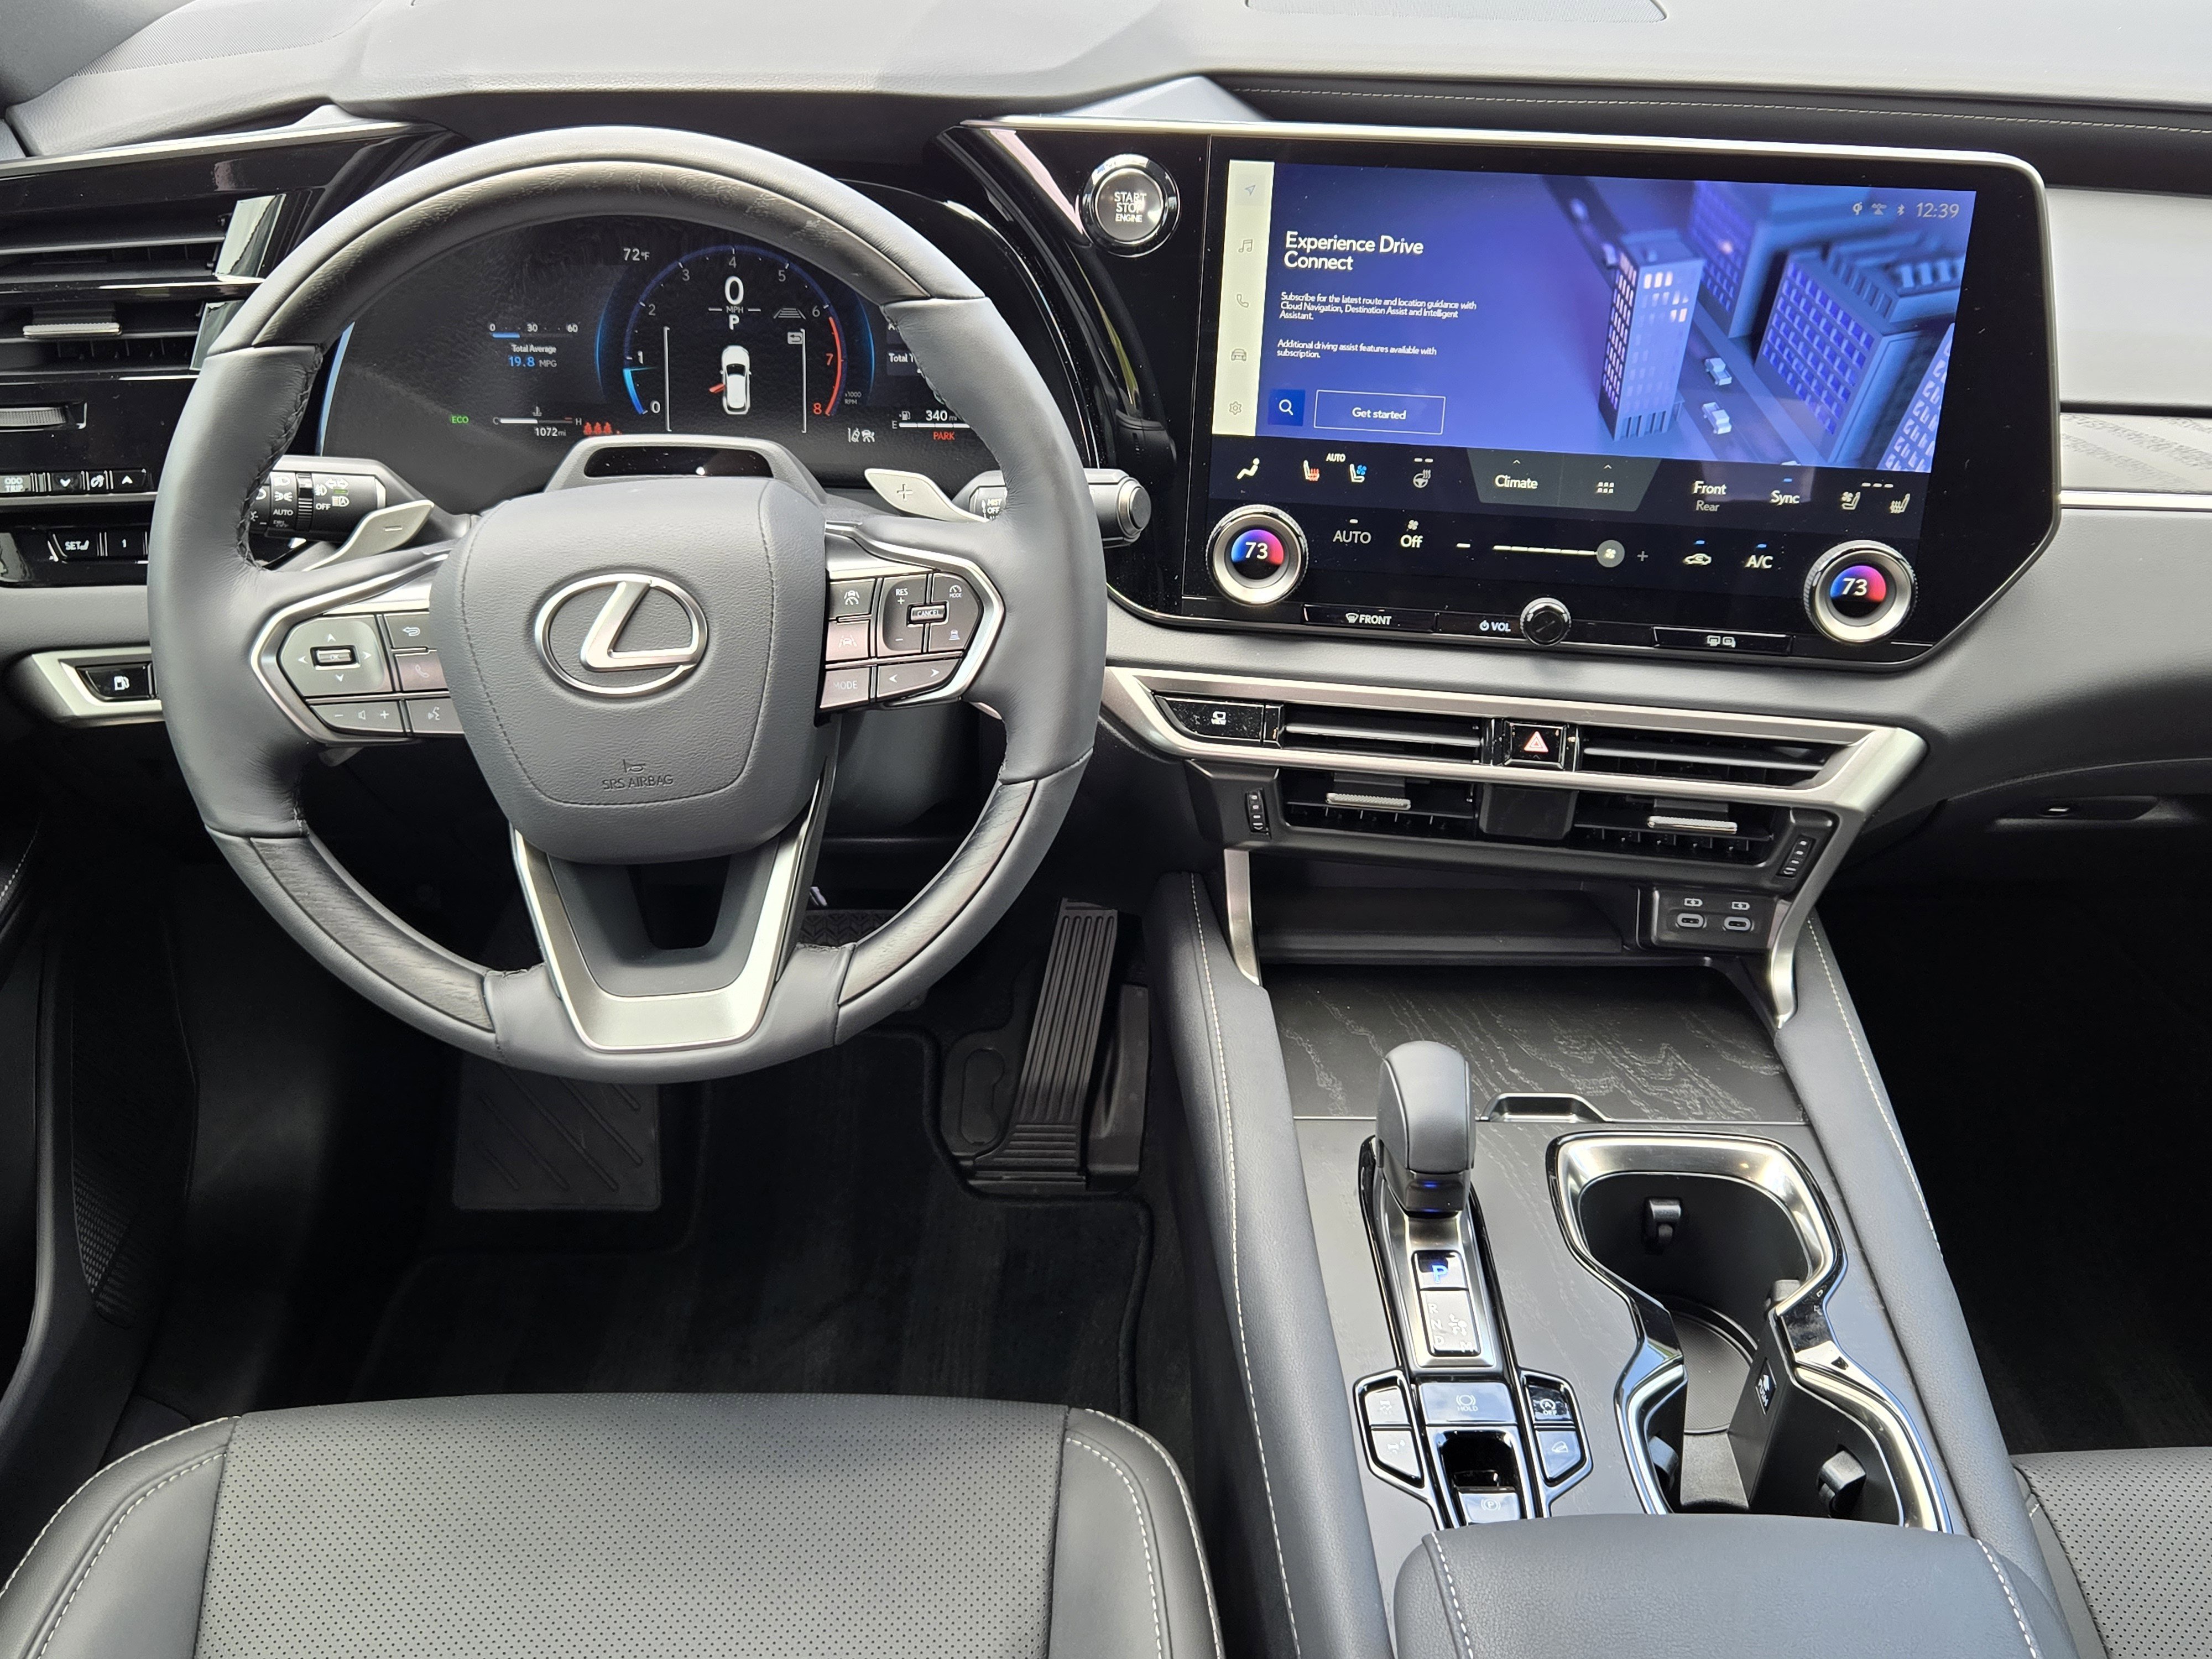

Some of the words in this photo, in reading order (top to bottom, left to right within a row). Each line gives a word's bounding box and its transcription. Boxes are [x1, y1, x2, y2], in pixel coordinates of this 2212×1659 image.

[1114, 191, 1147, 203] START
[1115, 202, 1144, 213] STOP
[1916, 202, 1959, 218] 12:39
[1115, 213, 1142, 222] ENGINE
[1286, 231, 1375, 252] Experience
[1379, 235, 1424, 254] Drive
[728, 257, 737, 268] 4
[1284, 251, 1354, 270] Connect
[682, 269, 690, 281] 3
[778, 270, 786, 282] 5
[724, 276, 744, 305] 0
[1281, 291, 1316, 302] Subscribe
[1317, 294, 1327, 302] for
[1329, 294, 1340, 303] the
[1342, 295, 1361, 304] latest
[1398, 298, 1426, 307] location
[1427, 300, 1459, 309] guidance
[1460, 301, 1477, 310] with
[648, 304, 656, 316] 2
[812, 306, 820, 317] 6
[1279, 310, 1314, 320] Assistant.
[1281, 301, 1302, 310] Cloud
[1303, 303, 1343, 314] Navigation,
[1345, 305, 1385, 315] Destination
[1386, 306, 1407, 315] Assist
[1408, 308, 1422, 316] and
[1423, 308, 1458, 319] Intelligent
[489, 324, 495, 332] 0
[527, 324, 538, 332] 30
[567, 324, 578, 332] 60
[729, 315, 740, 330] P
[529, 345, 557, 354] Average
[1277, 338, 1313, 349] Additional
[1314, 341, 1338, 352] driving
[1359, 343, 1389, 353] features
[1389, 345, 1420, 354] available
[1421, 346, 1437, 356] with
[1277, 348, 1321, 358] subscription.
[509, 356, 535, 367] 19.8
[539, 359, 557, 368] MPG
[638, 351, 644, 364] 1
[826, 353, 833, 365] 7
[888, 353, 908, 363] Total
[650, 400, 661, 414] 0
[813, 403, 822, 415] 8
[926, 410, 948, 421] 340
[1352, 407, 1371, 419] Get
[1373, 409, 1406, 420] started
[492, 417, 498, 425] C
[892, 421, 898, 429] E
[933, 431, 955, 441] PARK
[1326, 453, 1346, 463] AUTO
[1495, 474, 1538, 490] Climate
[1693, 481, 1726, 495] Front
[1771, 490, 1800, 506] Sync
[1695, 501, 1720, 512] Rear
[122, 539, 127, 547] 1
[1333, 530, 1372, 544] AUTO
[1400, 534, 1423, 548] Off
[1244, 542, 1269, 560] 73
[1745, 555, 1773, 569] A/C
[1843, 578, 1868, 596] 73
[1359, 613, 1392, 625] FRONT
[1491, 622, 1511, 632] VOL
[834, 681, 858, 690] MODE
[602, 778, 625, 790] SRS
[628, 774, 674, 789] AIRBAG
[1432, 1265, 1449, 1283] P
[1428, 1303, 1438, 1314] R
[1431, 1319, 1442, 1330] N
[1434, 1335, 1445, 1346] D
[1460, 1341, 1474, 1353] M
[1758, 1378, 1768, 1406] PUSH
